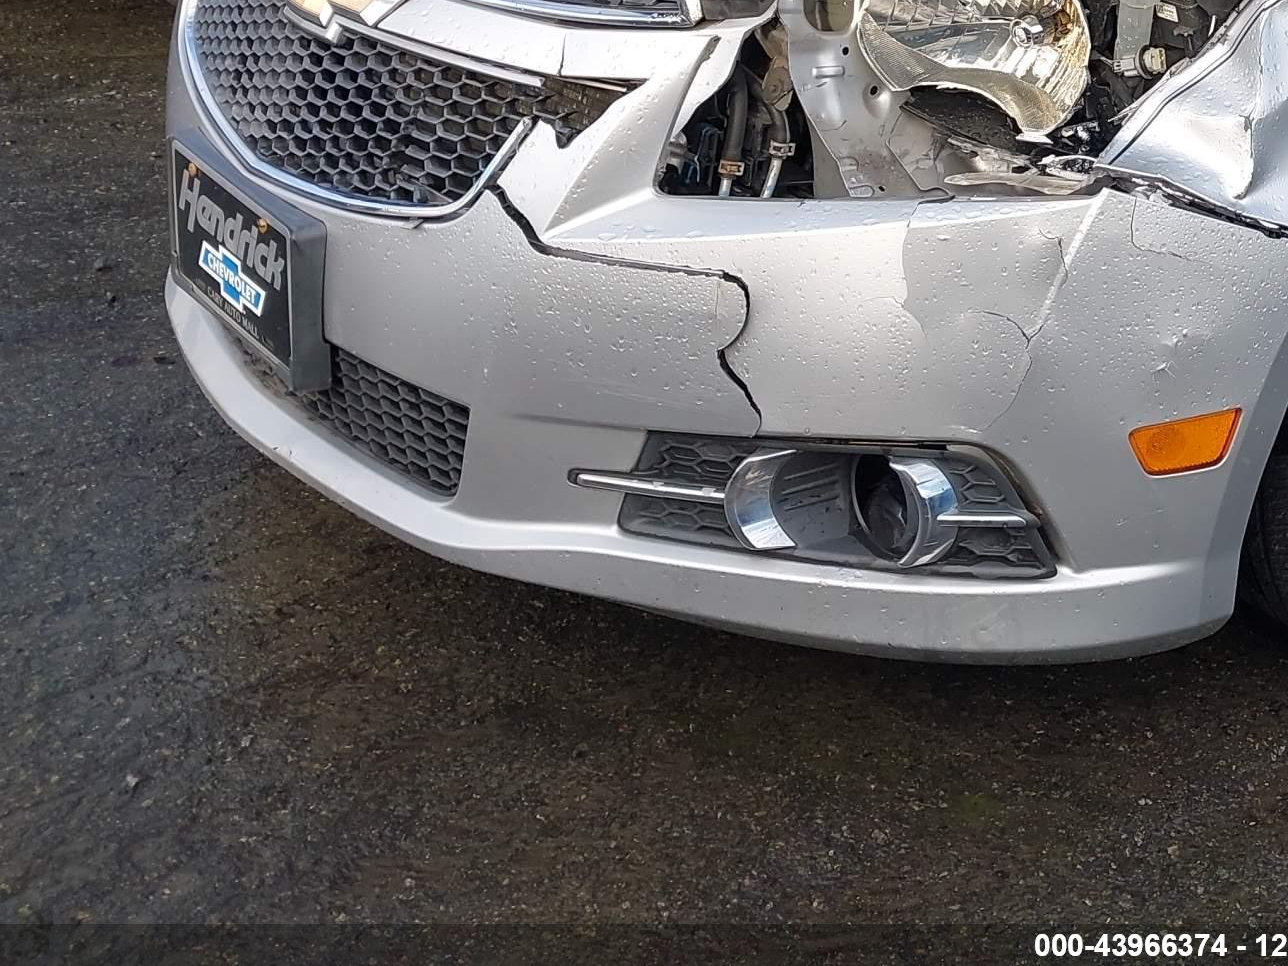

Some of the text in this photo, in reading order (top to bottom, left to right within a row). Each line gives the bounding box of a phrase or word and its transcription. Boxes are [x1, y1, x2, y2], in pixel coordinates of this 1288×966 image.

[178, 169, 285, 290] Hendrick
[207, 252, 257, 305] CHEVROLET
[224, 301, 241, 323] AUTO
